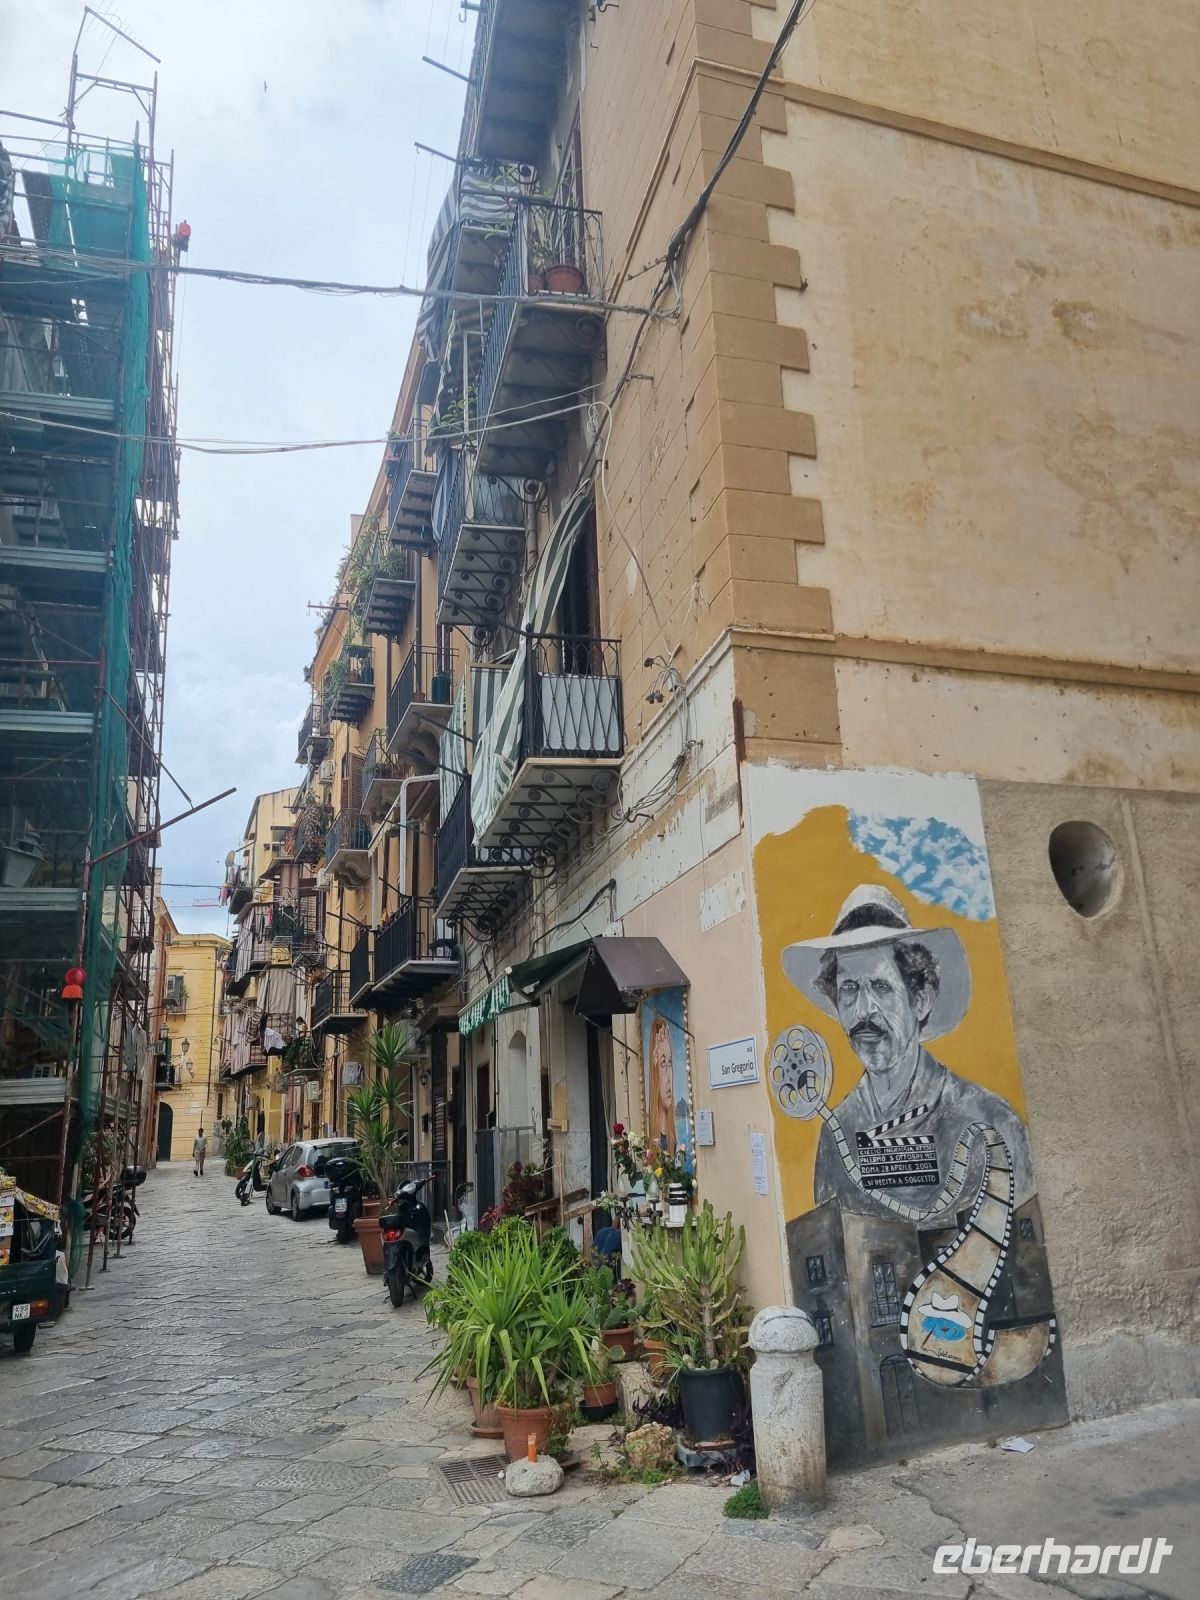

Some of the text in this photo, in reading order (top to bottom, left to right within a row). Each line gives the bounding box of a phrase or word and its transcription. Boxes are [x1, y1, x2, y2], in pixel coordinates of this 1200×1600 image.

[721, 1060, 754, 1075] San Gregorio
[860, 1156, 886, 1164] PALERMO
[861, 1165, 880, 1174] ROMA
[890, 1164, 913, 1172] APRILE
[874, 1178, 896, 1186] RECITA
[897, 1177, 903, 1185] A
[904, 1174, 936, 1184] SOGGETTO
